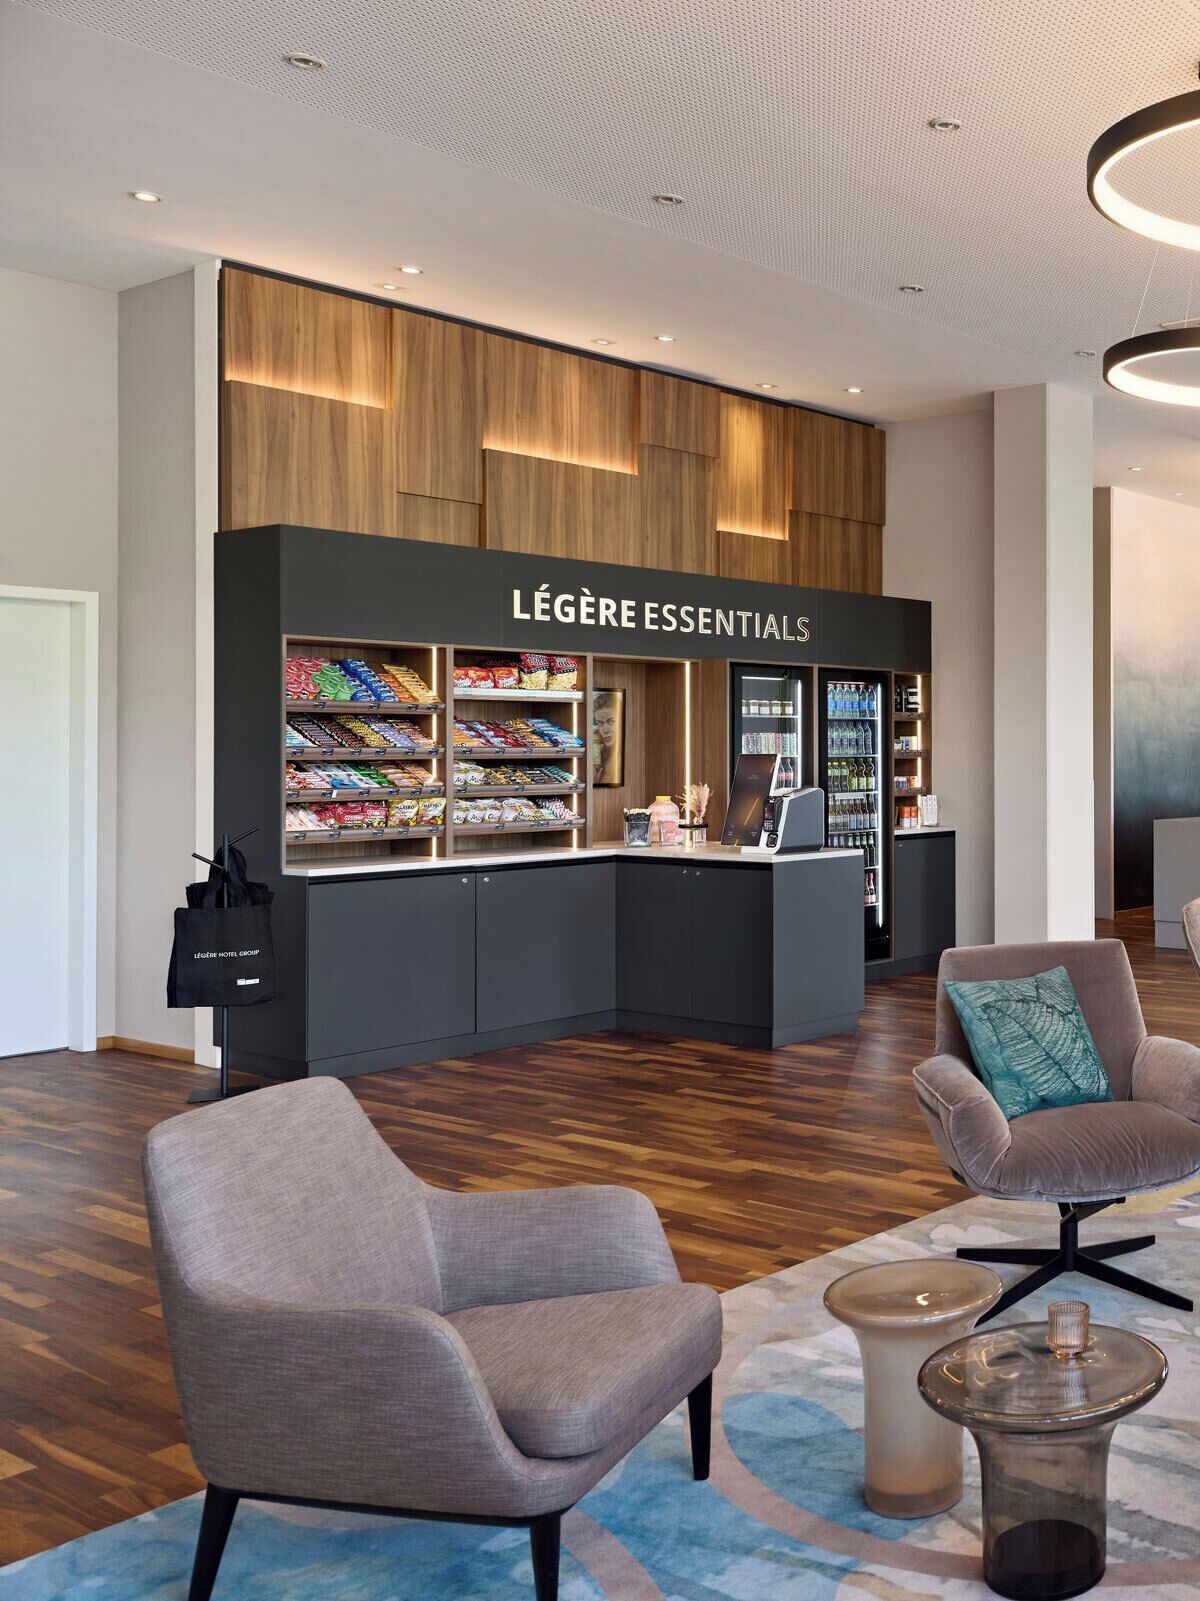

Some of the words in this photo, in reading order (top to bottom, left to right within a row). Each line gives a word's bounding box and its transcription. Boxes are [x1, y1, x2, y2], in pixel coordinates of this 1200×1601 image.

[513, 584, 636, 628] LÉGÈRE
[644, 602, 810, 642] ESSENTIALS
[239, 949, 260, 957] GROUP
